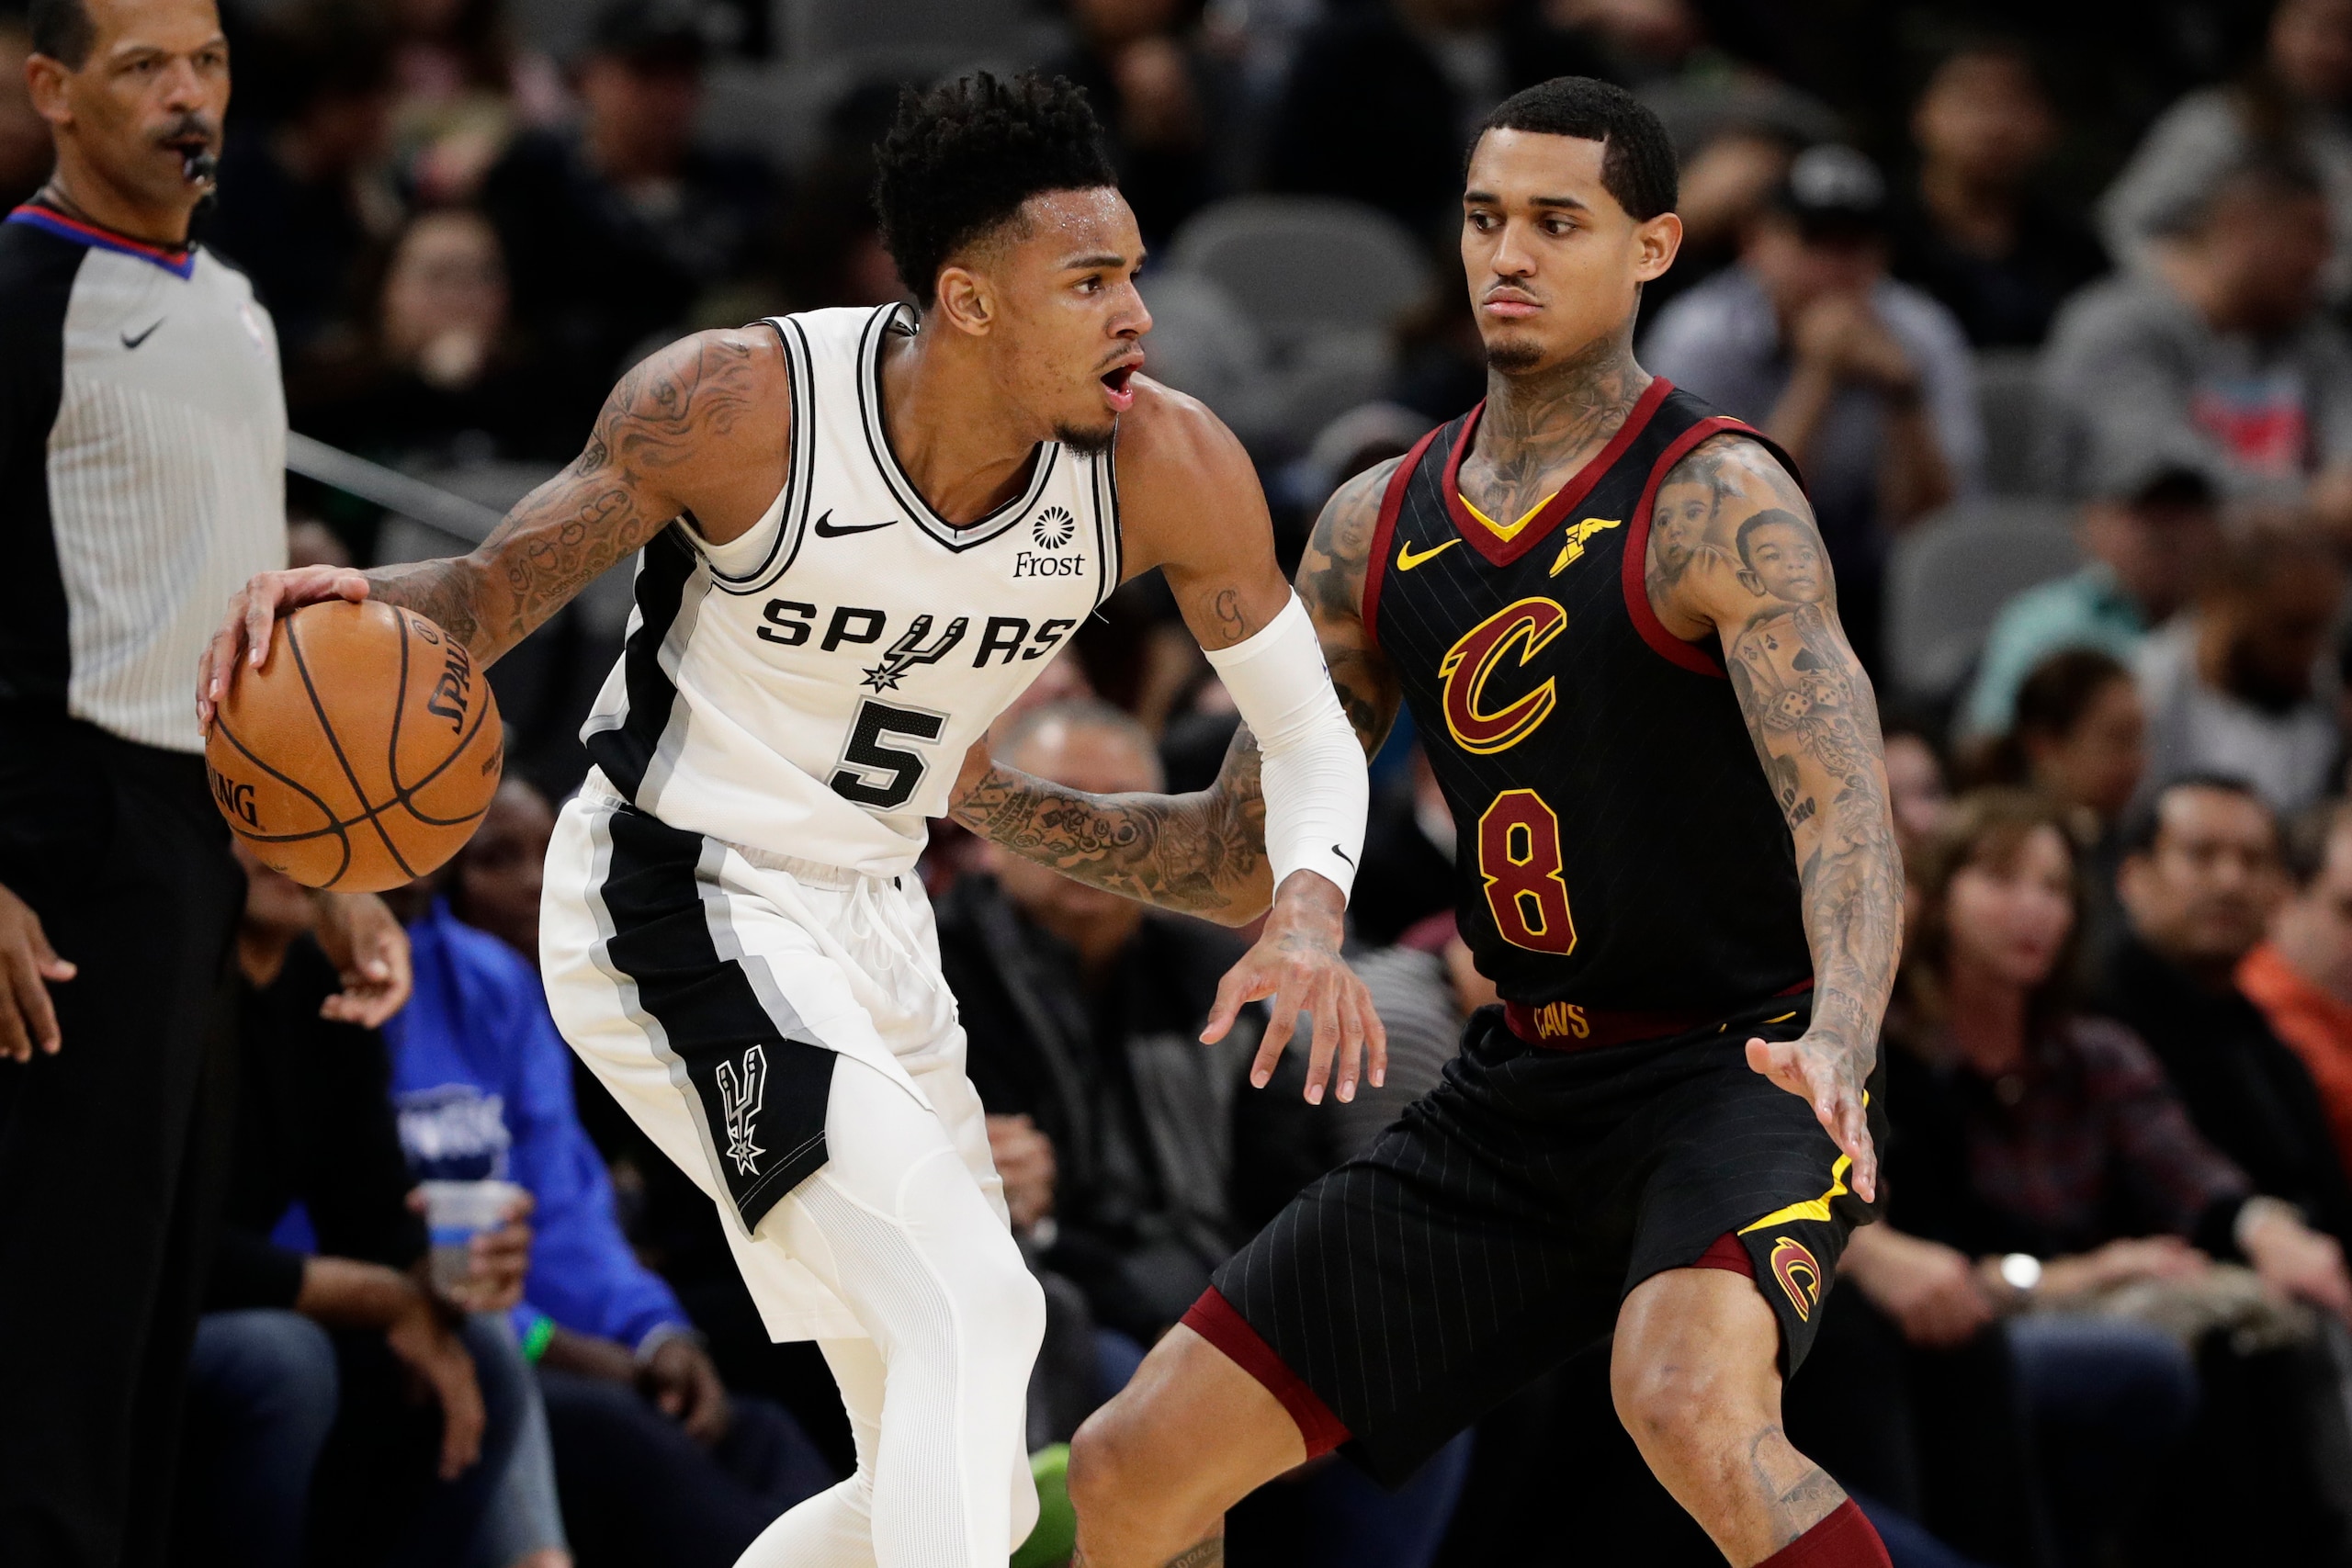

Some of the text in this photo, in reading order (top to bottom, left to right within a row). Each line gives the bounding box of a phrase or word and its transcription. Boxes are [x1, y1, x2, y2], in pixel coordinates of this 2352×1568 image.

[1012, 551, 1086, 578] Frost
[756, 598, 1077, 694] SPURS
[1438, 596, 1567, 755] C
[827, 694, 951, 813] 5
[1478, 788, 1577, 956] 8
[1533, 1000, 1590, 1040] CAVS
[1770, 1235, 1822, 1323] C
